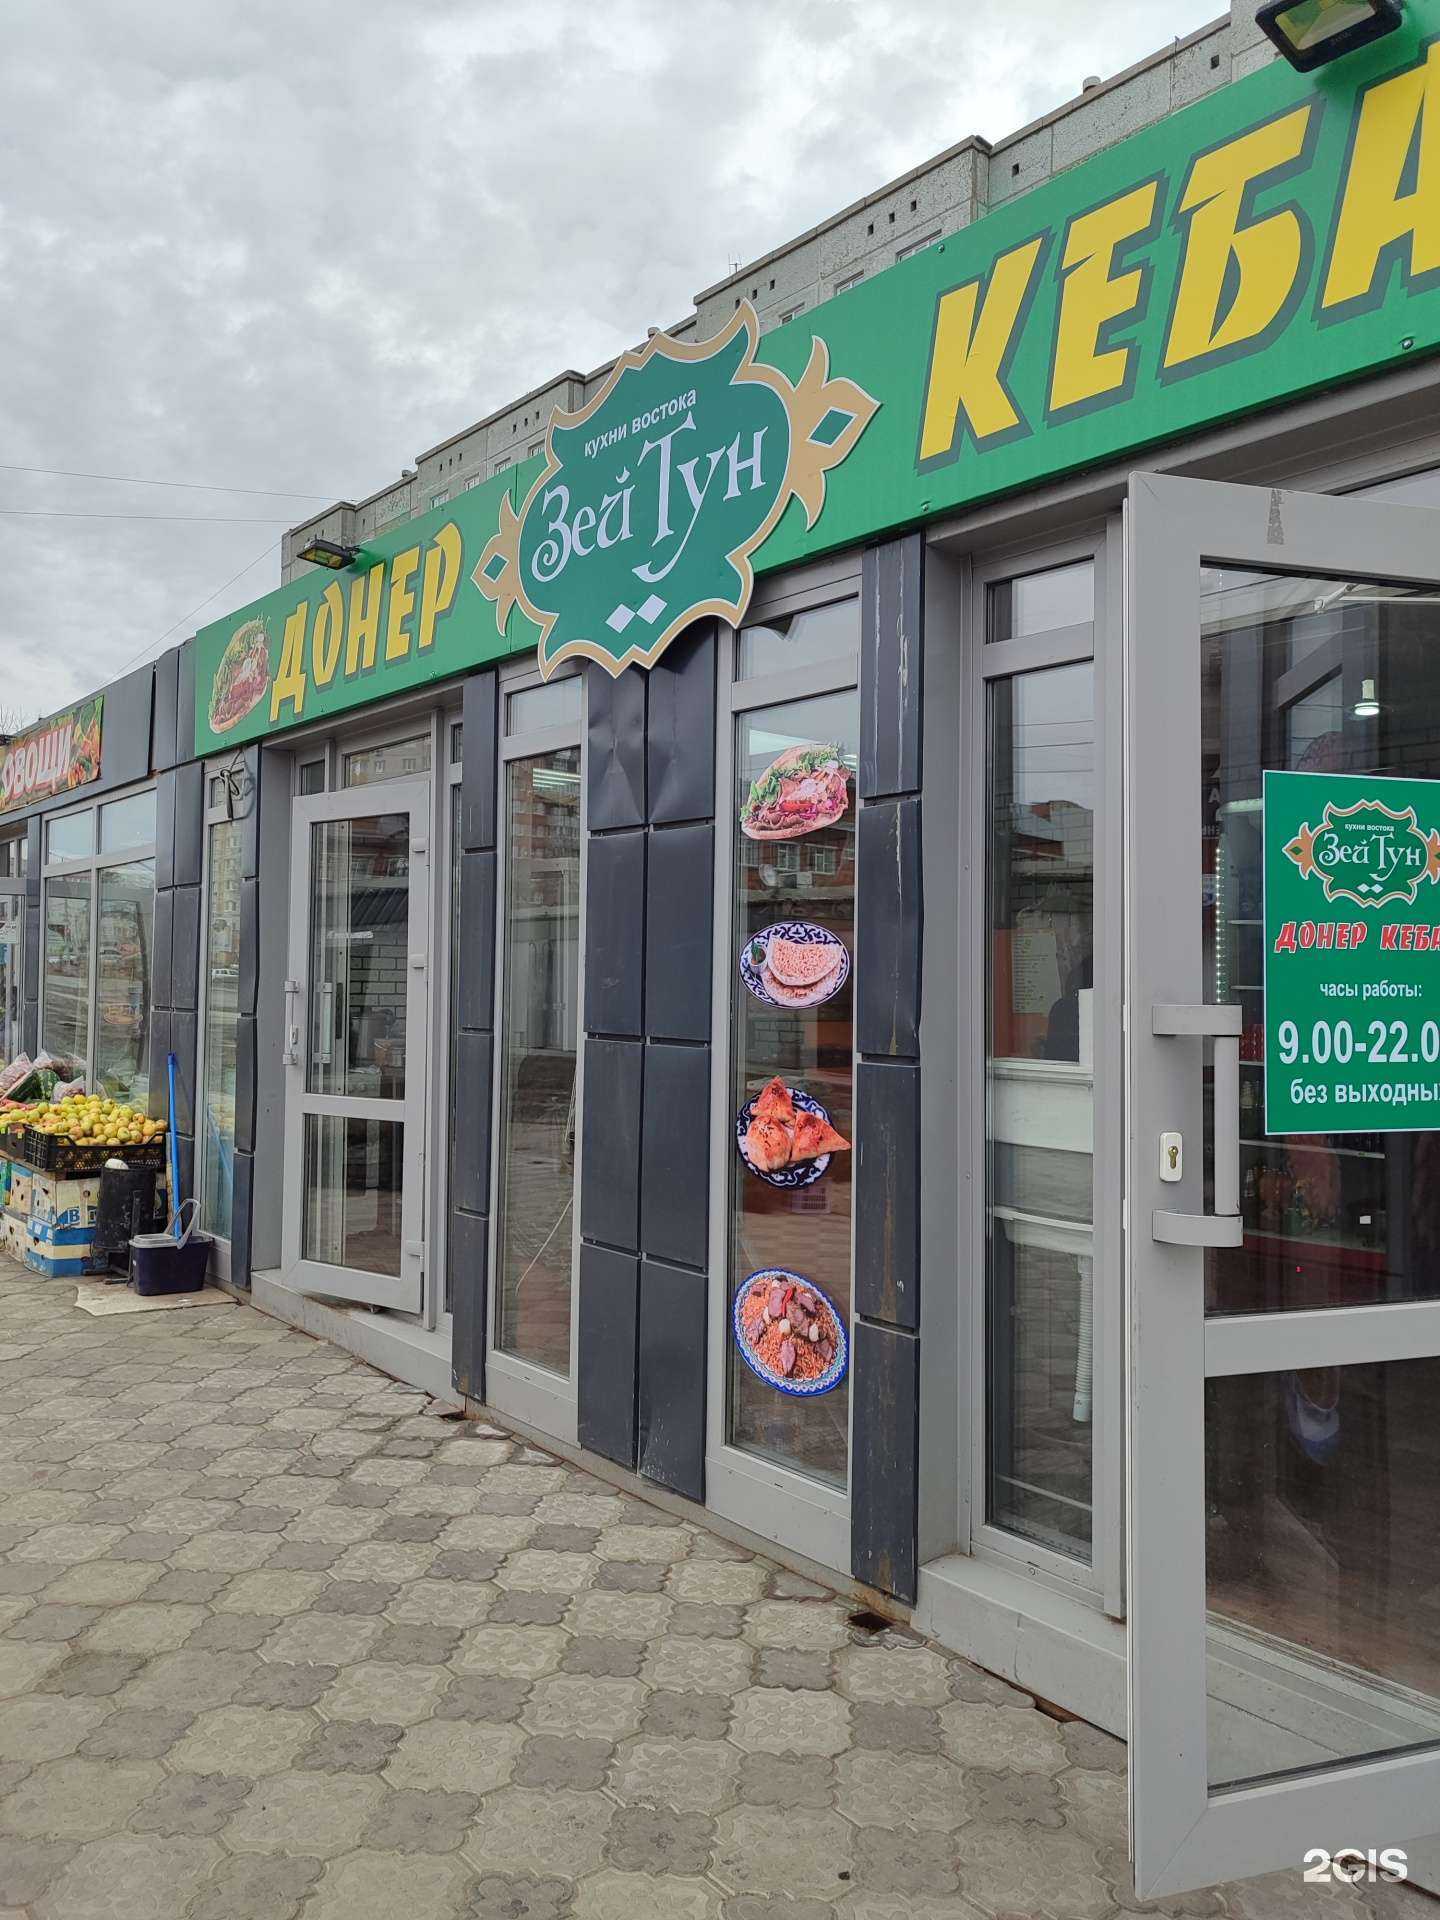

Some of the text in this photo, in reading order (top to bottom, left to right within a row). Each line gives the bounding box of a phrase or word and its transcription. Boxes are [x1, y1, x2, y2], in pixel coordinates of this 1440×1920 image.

[583, 388, 697, 458] кухни востока
[269, 522, 463, 723] ДОНЕР
[1, 723, 73, 798] ОВОЩИ
[1344, 823, 1395, 832] кухни востока
[1274, 921, 1368, 953] ДОНЕР
[1319, 980, 1423, 1001] часы работы:
[1290, 1078, 1440, 1107] без выходны
